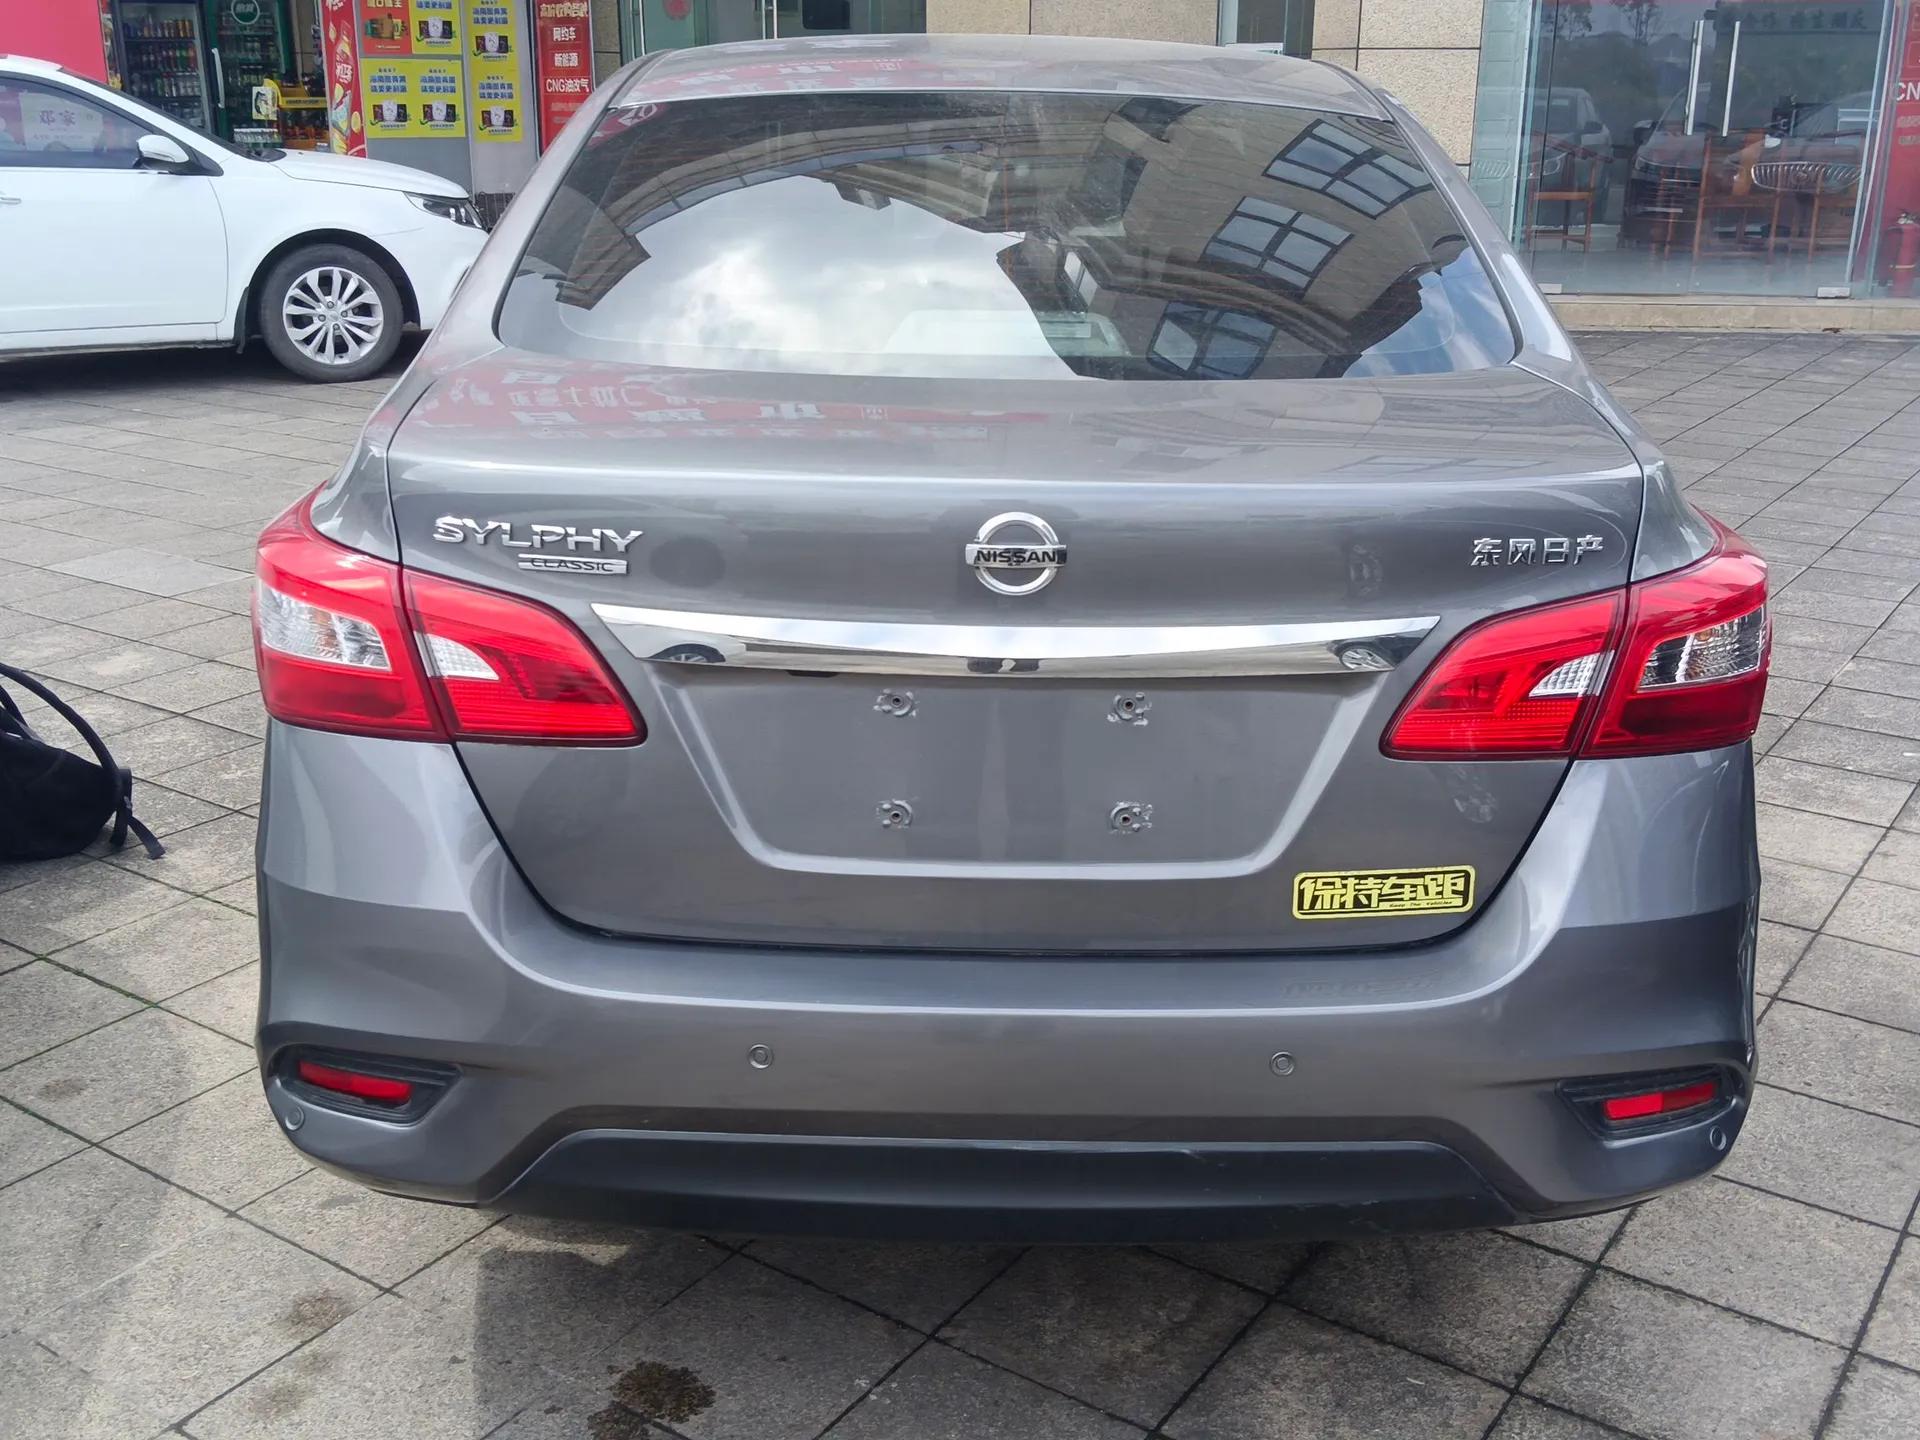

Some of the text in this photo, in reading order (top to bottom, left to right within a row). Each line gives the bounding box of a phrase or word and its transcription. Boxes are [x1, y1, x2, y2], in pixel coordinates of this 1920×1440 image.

[553, 26, 576, 42] 网约车
[554, 52, 579, 67] 新能源
[546, 77, 590, 93] CNG油改气
[432, 515, 643, 553] SYLPHY
[976, 550, 1057, 563] NISSAN
[1470, 534, 1604, 566] 东风日产
[531, 556, 614, 572] CLASSIC
[1299, 873, 1466, 910] 保持车距
